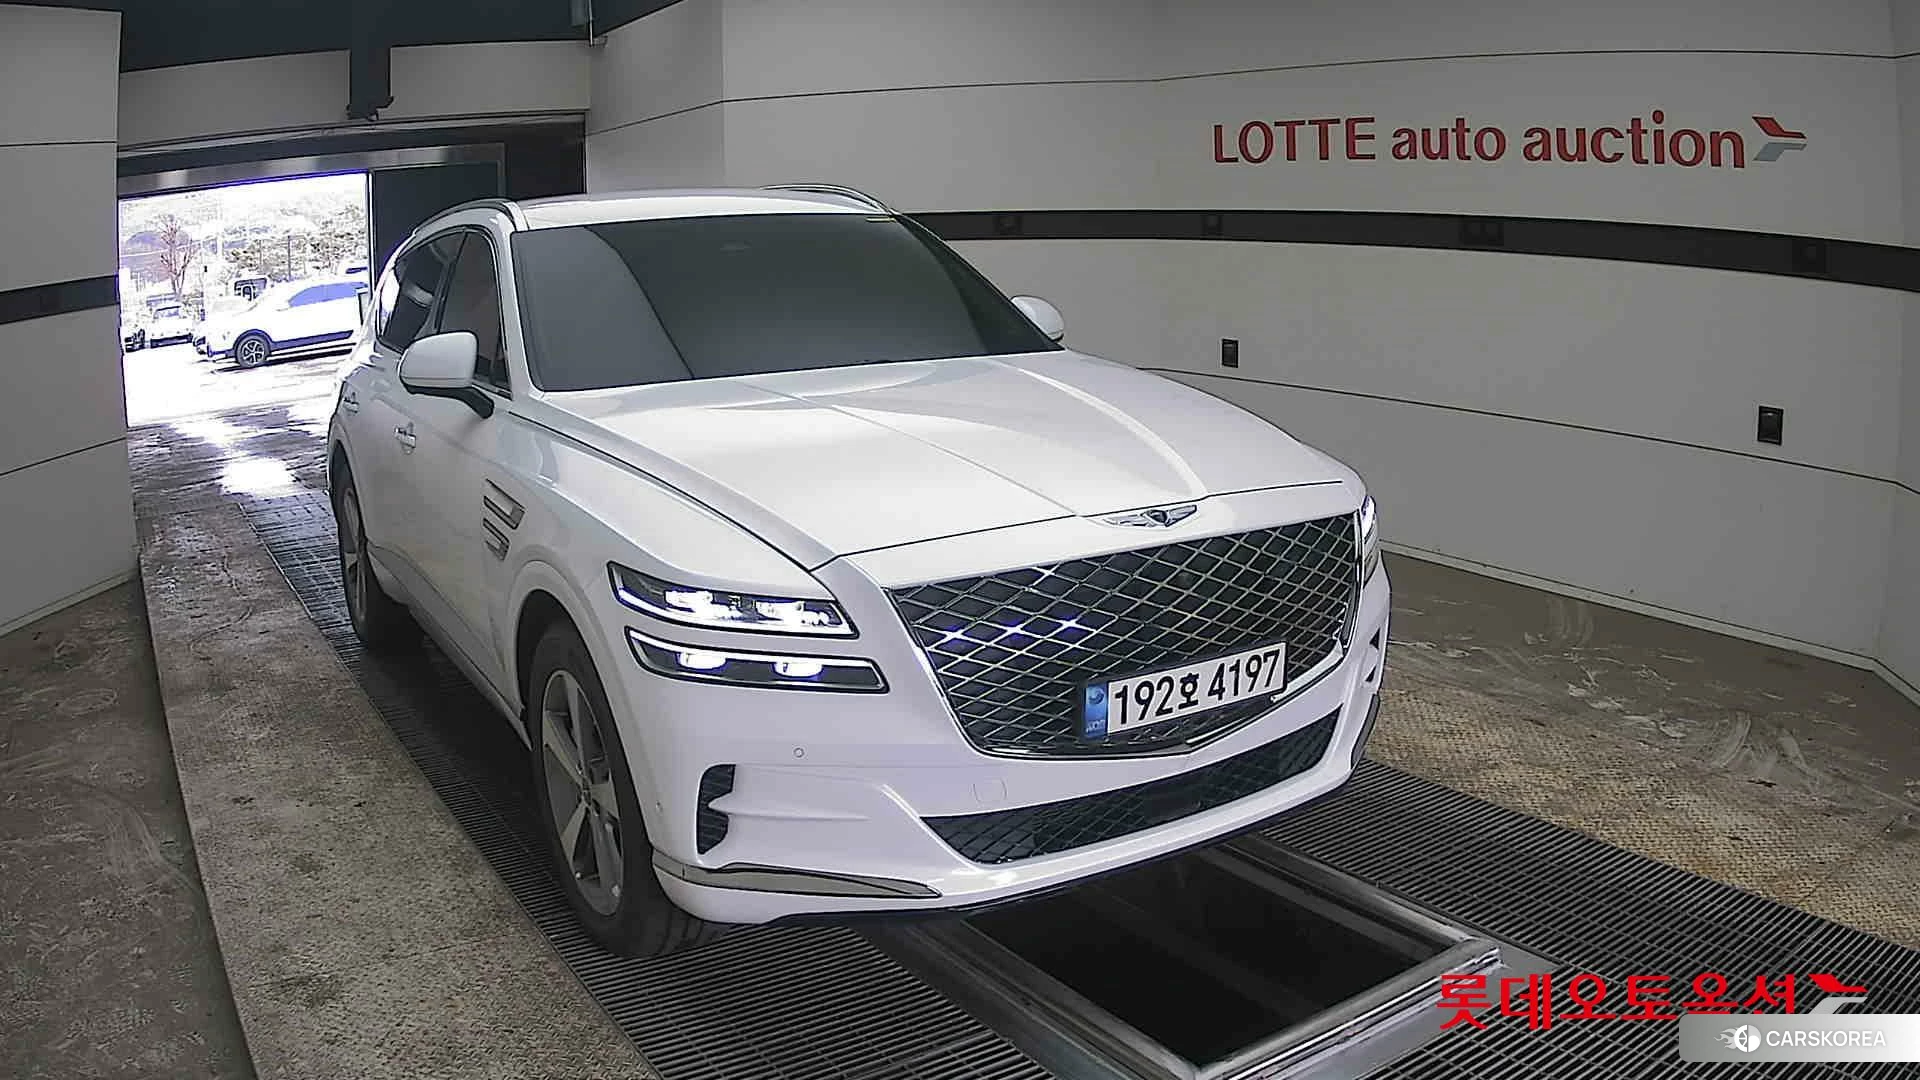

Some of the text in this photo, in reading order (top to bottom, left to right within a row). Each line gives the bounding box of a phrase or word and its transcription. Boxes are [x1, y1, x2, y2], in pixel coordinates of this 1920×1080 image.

[1212, 109, 1746, 169] LOTTE auto auction
[1114, 648, 1281, 726] 192호 4197
